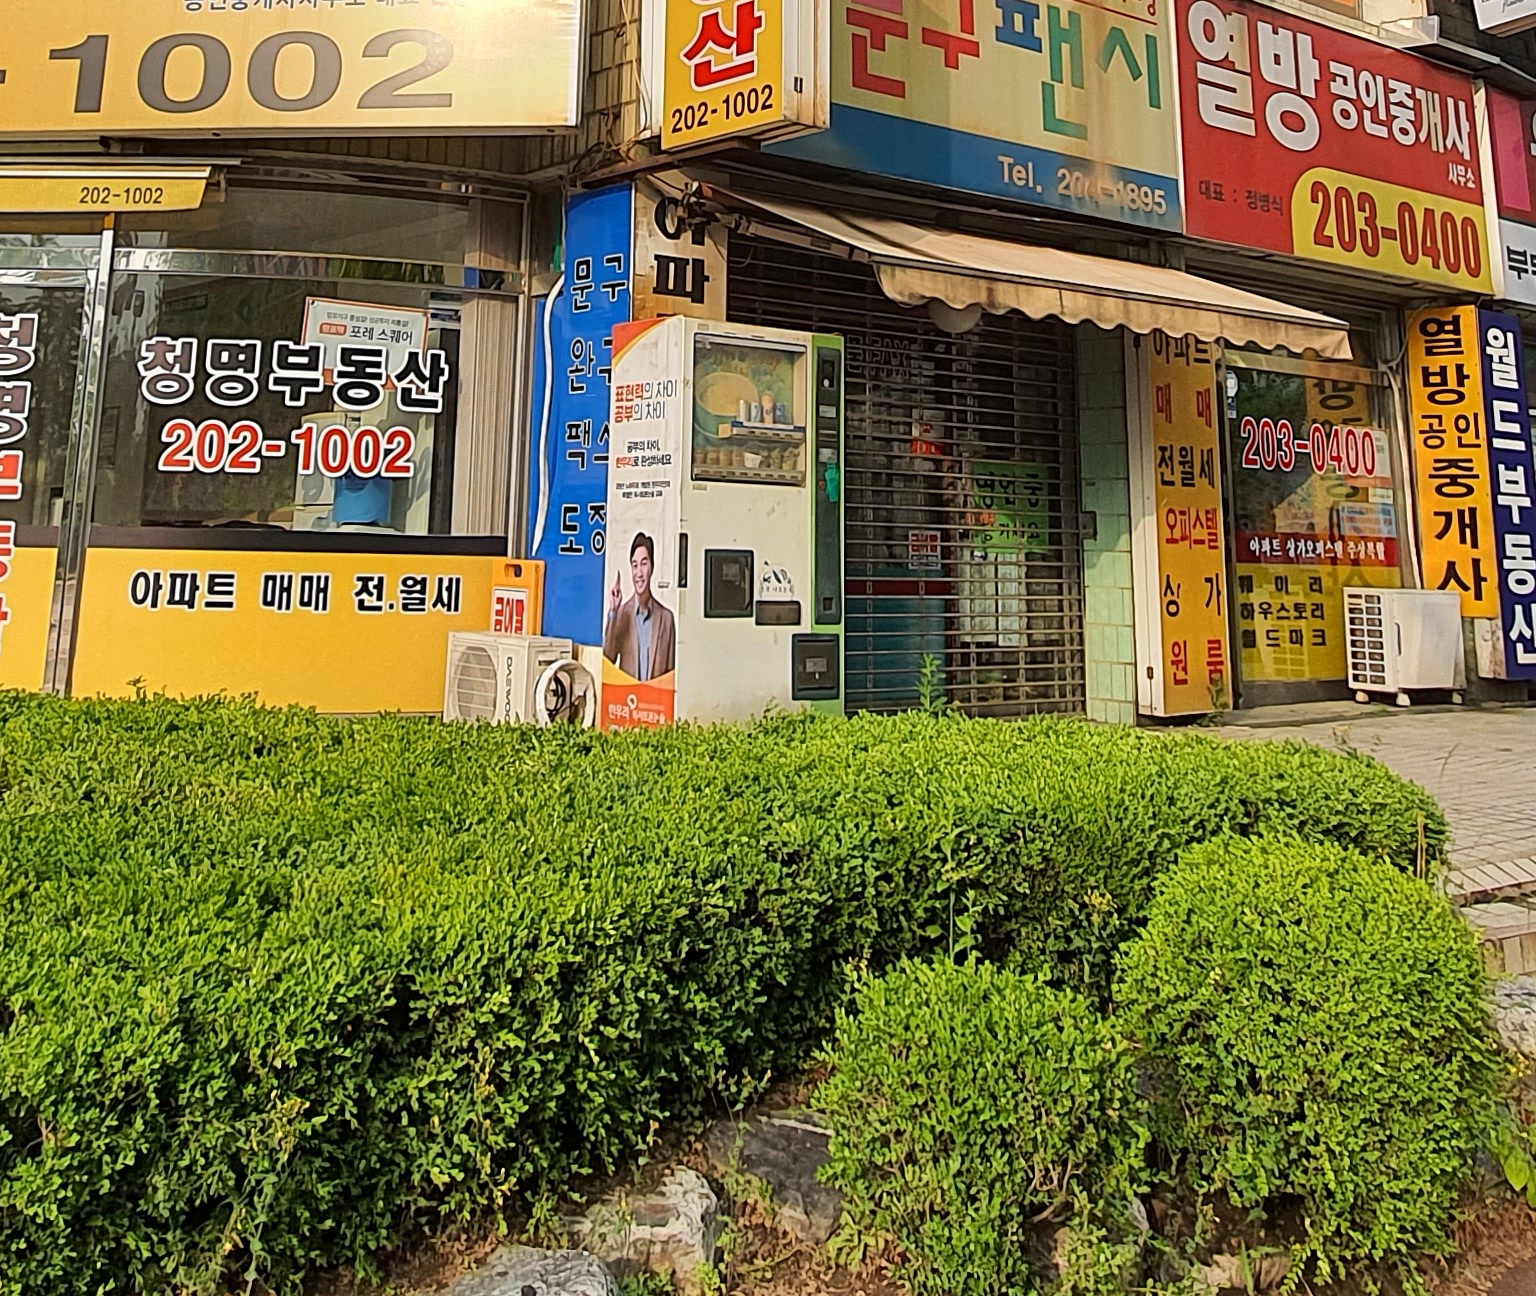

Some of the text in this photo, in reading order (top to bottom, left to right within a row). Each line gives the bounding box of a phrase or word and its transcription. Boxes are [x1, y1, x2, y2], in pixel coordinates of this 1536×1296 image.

[1187, 1, 1471, 161] 열방 공인중개사
[671, 84, 774, 135] 202-1002
[79, 186, 164, 205] 202-1002
[997, 155, 1042, 191] Tel.
[1199, 180, 1224, 202] 대표
[1448, 161, 1476, 189] 사무소
[1310, 181, 1482, 279] 203-0400
[570, 253, 627, 313] 문구
[349, 326, 413, 345] 포레 스퀘어
[1152, 331, 1212, 366] 아파트
[138, 337, 449, 412] 청명부동산
[1418, 315, 1470, 406] 열방
[615, 379, 677, 402] 표현력의 차이
[615, 401, 665, 423] 공부의 차이
[159, 420, 414, 478] 202-1002
[1157, 445, 1215, 490] 전월세
[1240, 416, 1377, 477] 203-0400
[1165, 506, 1219, 551] 오피스텔
[1249, 536, 1282, 557] 아파트
[130, 571, 461, 614] 아파트 매매 전.월세
[1163, 572, 1222, 618] 상가
[1240, 602, 1326, 621] 하우스토리
[1171, 639, 1224, 687] 원룸
